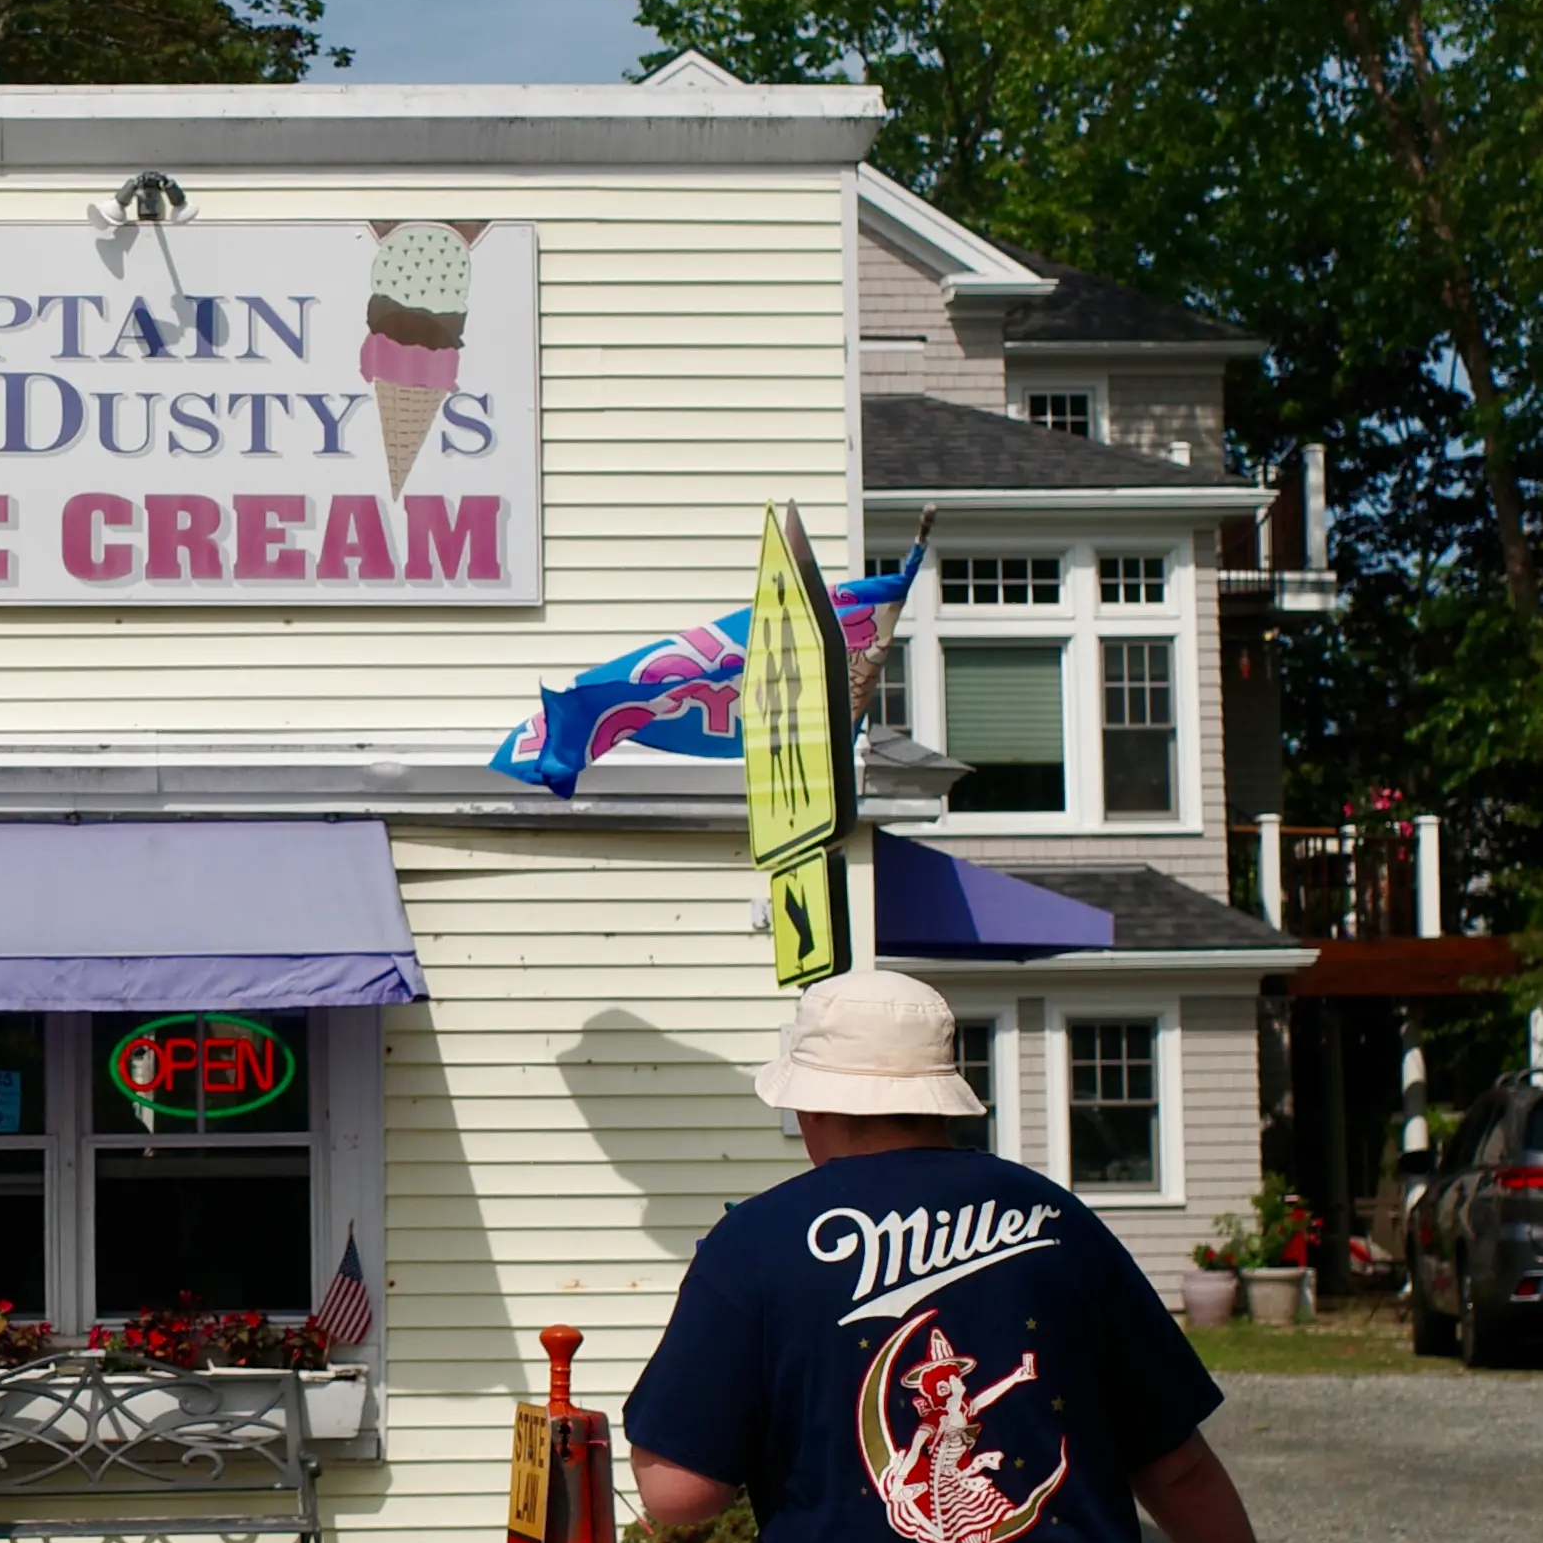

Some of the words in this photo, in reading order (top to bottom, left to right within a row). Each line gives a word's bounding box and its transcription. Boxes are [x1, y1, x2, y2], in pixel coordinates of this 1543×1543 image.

[62, 493, 502, 581] CREAM
[118, 1037, 274, 1092] OPEN
[807, 1199, 1061, 1302] Miller
[515, 1411, 546, 1469] STATE
[515, 1468, 540, 1524] LAW
